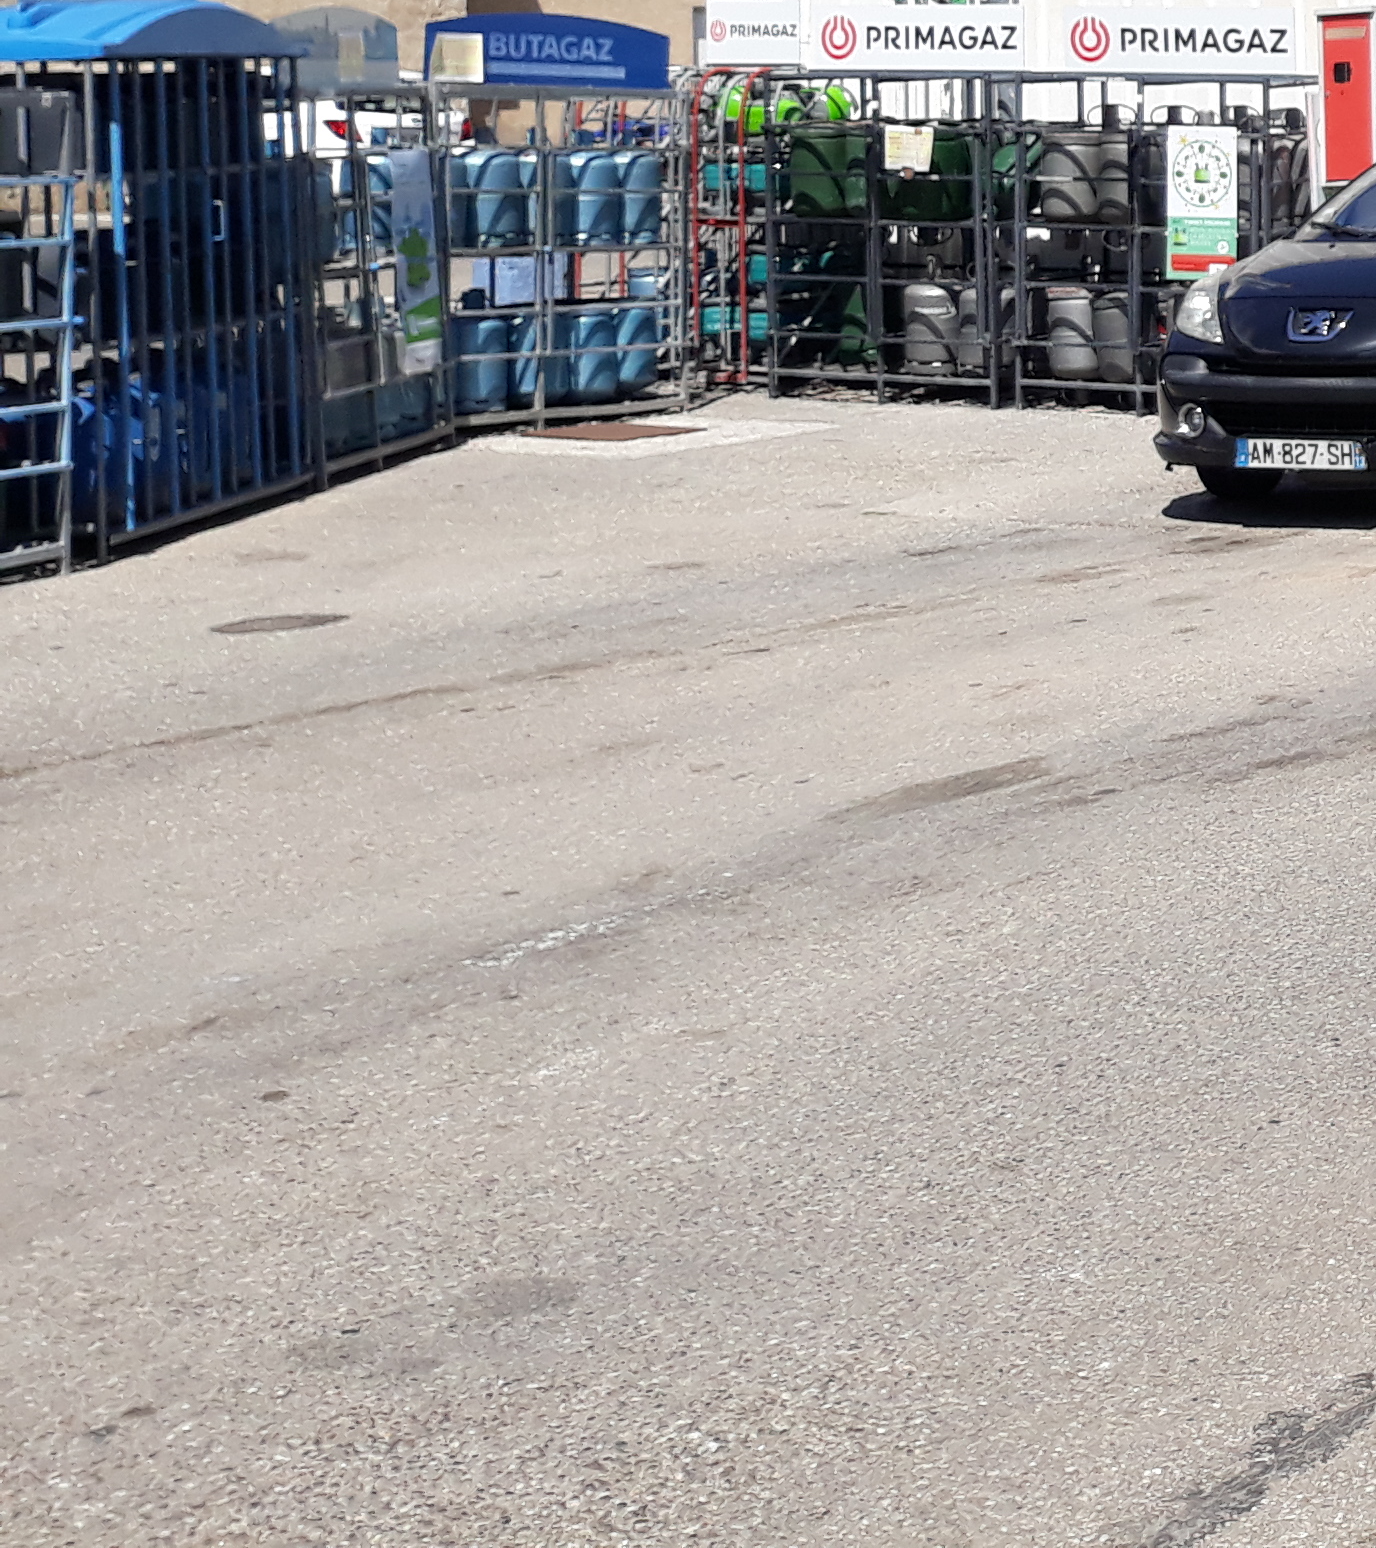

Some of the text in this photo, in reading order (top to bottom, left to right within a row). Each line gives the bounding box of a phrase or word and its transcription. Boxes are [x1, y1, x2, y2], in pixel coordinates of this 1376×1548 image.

[729, 24, 798, 38] PRIMAGAZ
[866, 25, 1018, 51] PRIMAGAZ
[1120, 28, 1289, 54] PRIMAGAZ
[488, 32, 614, 62] BUTAGAZ
